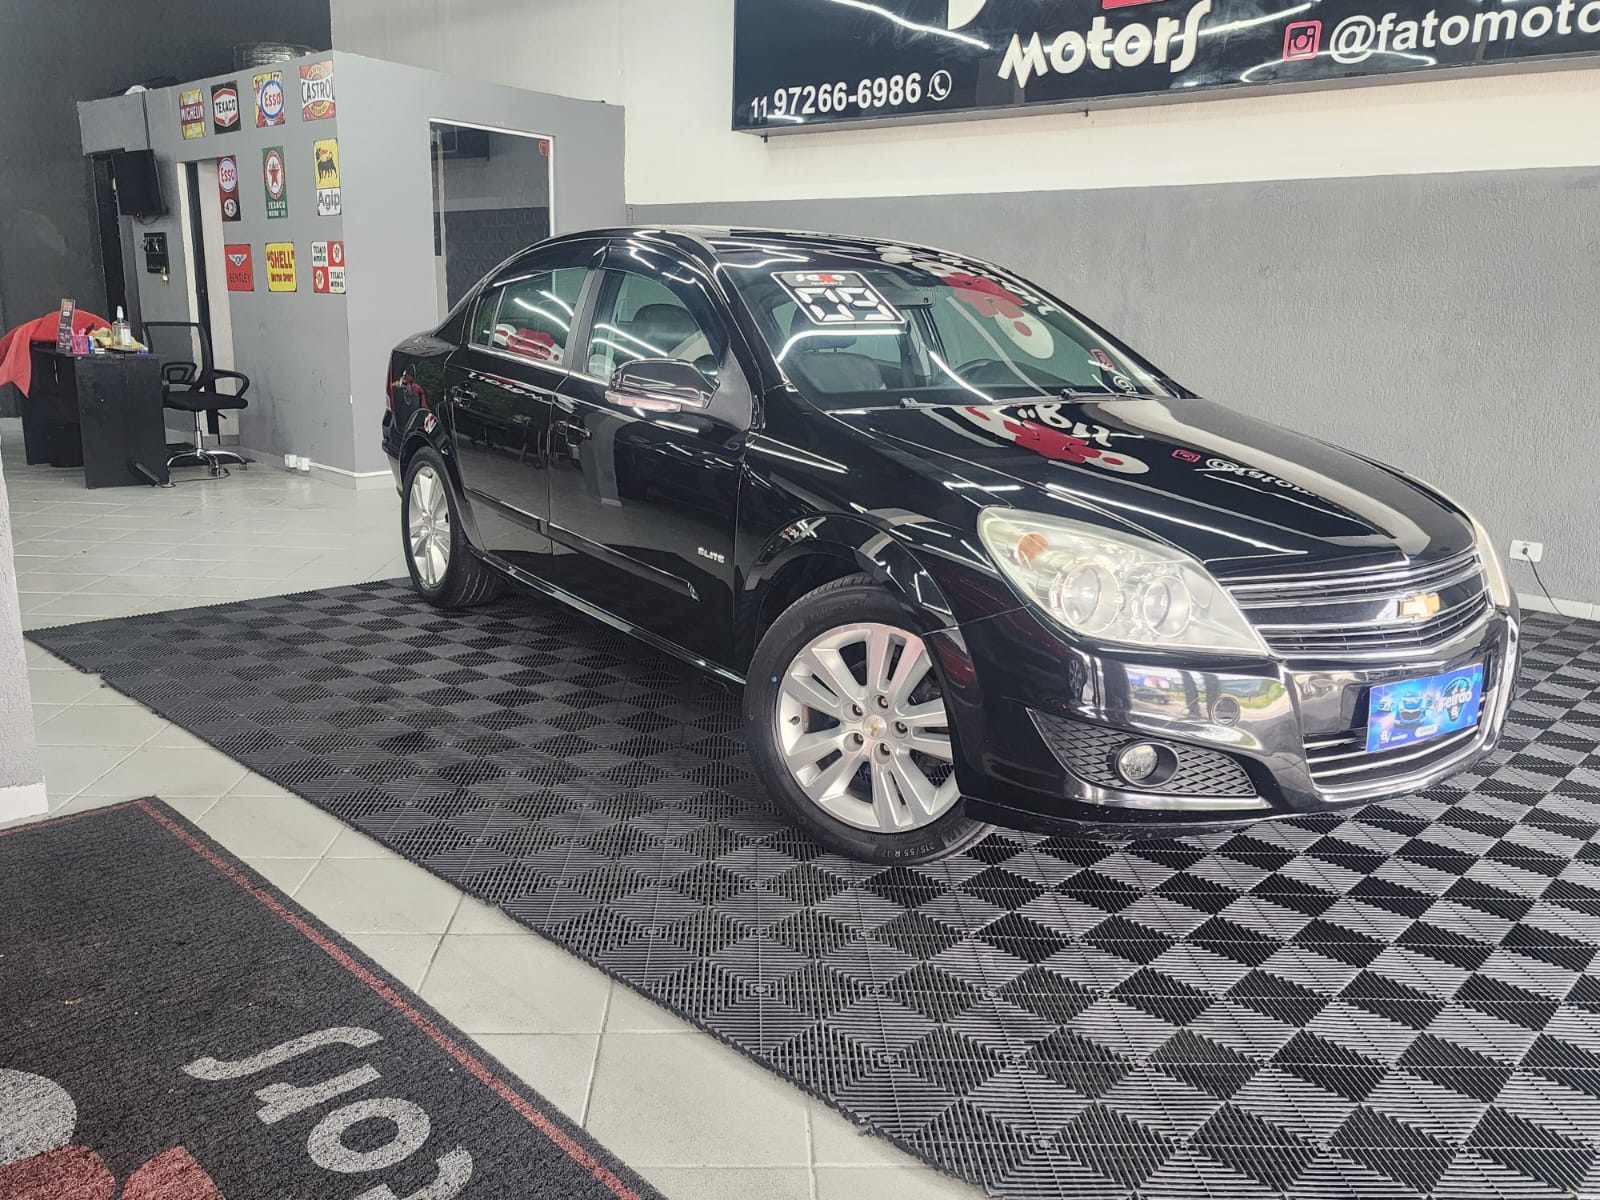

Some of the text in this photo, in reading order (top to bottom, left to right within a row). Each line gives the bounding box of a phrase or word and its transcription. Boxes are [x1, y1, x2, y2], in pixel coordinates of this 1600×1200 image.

[301, 74, 336, 105] CASTROL
[750, 72, 922, 119] 11 97266-6986
[215, 99, 236, 114] TEXACO
[268, 201, 286, 209] TEXACO
[317, 191, 340, 210] Agip
[229, 272, 251, 284] BENTLEY
[330, 271, 344, 279] TEXACO
[794, 287, 896, 321] 09
